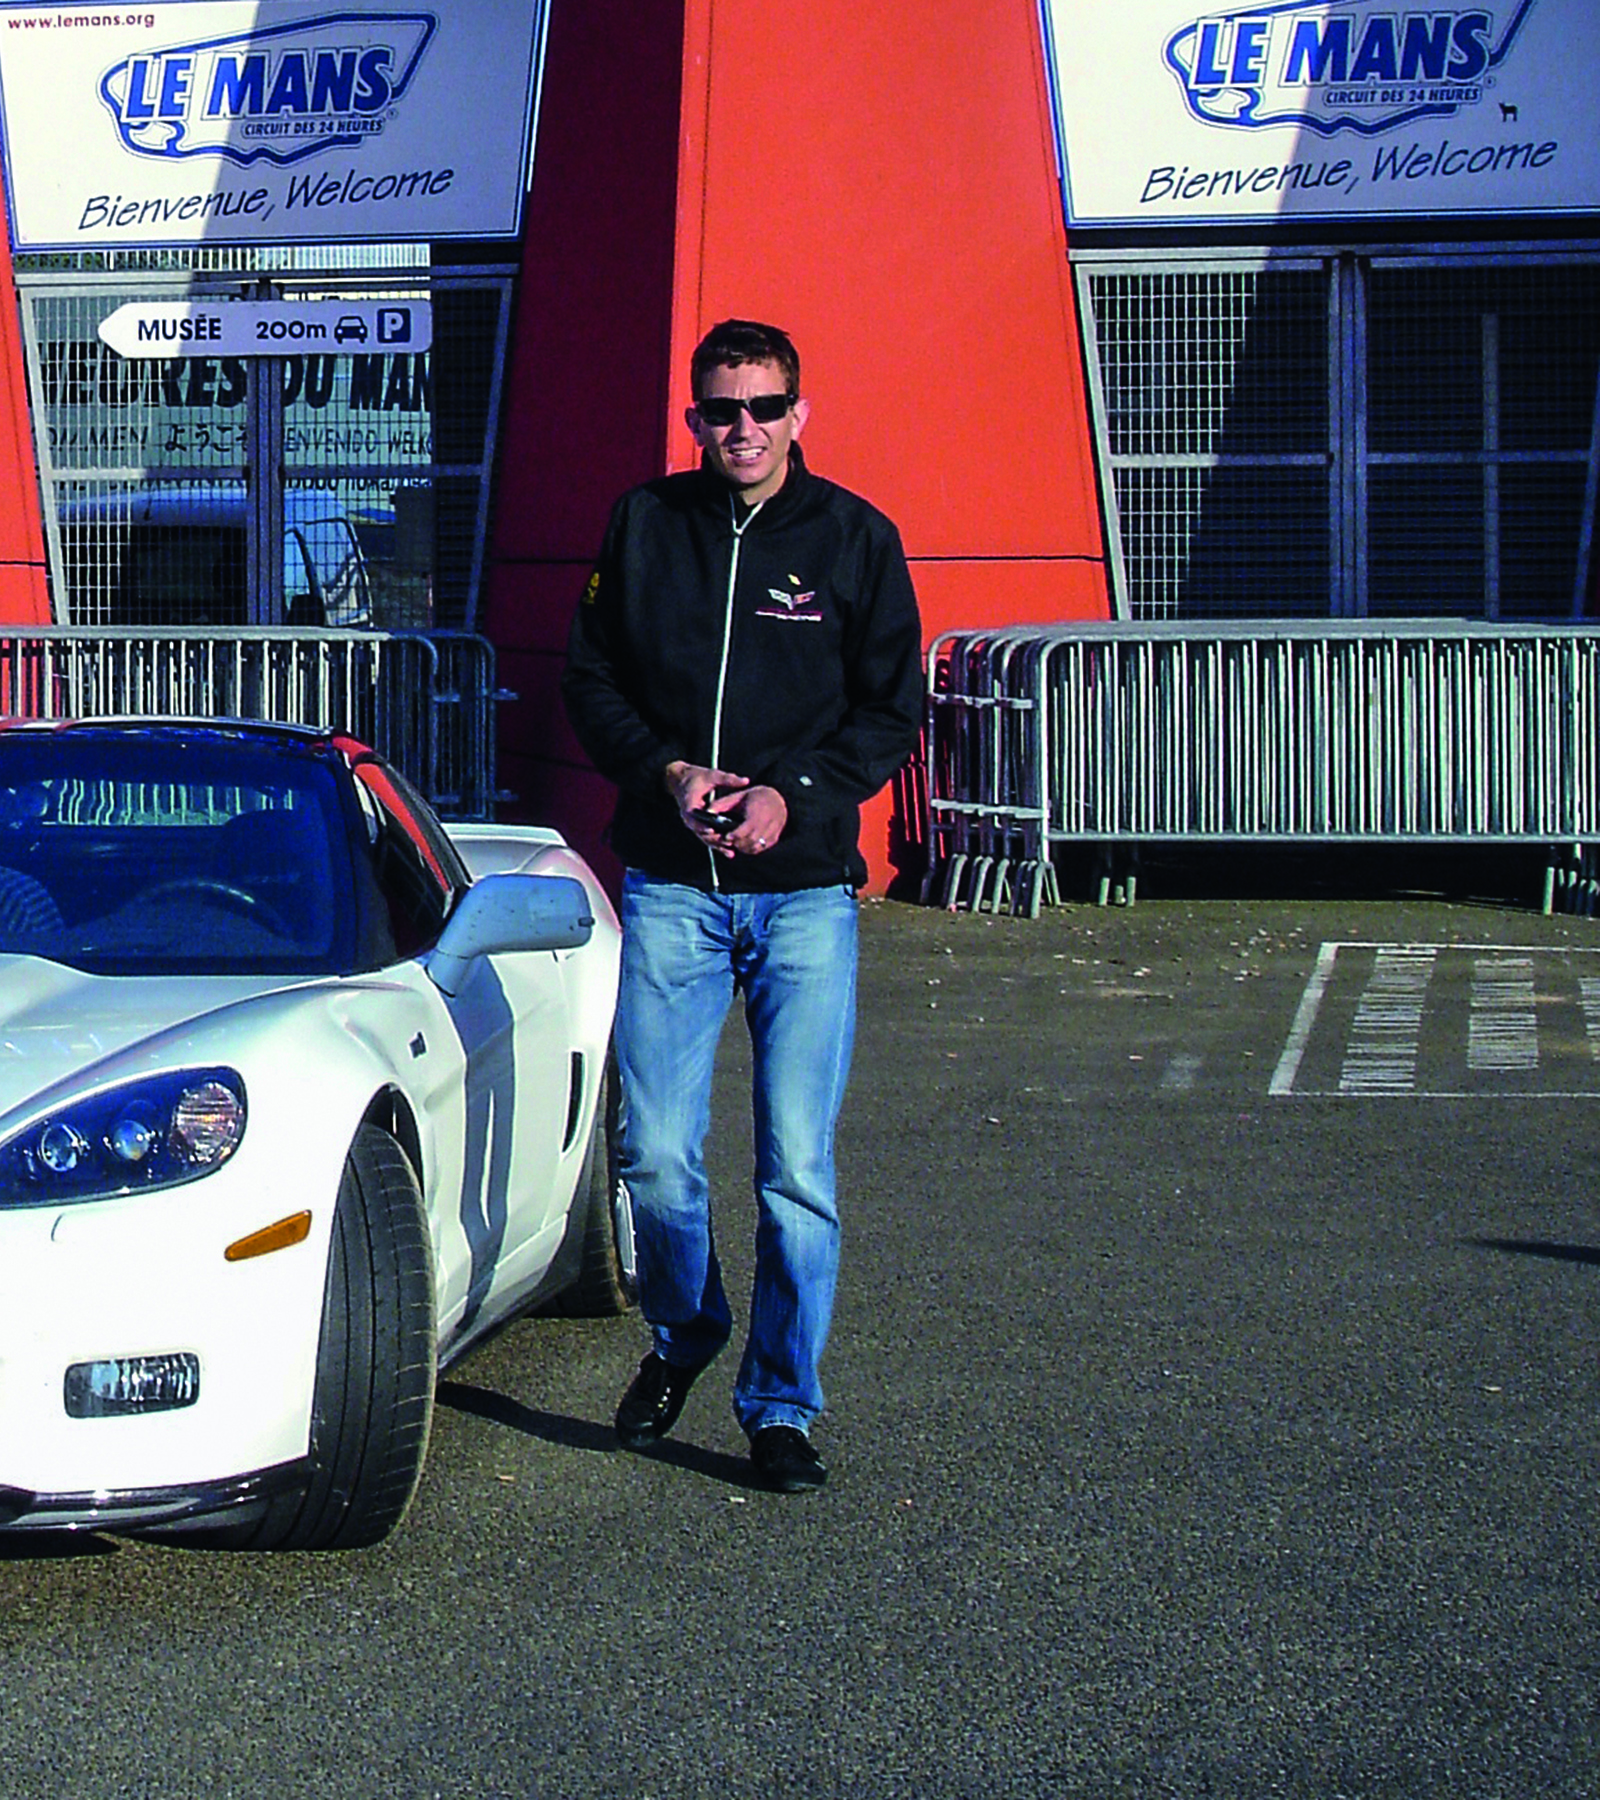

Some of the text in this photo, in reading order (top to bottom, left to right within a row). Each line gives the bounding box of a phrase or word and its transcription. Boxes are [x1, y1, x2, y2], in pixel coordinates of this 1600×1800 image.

[6, 12, 156, 30] www.lemans.org
[1192, 13, 1492, 87] LE MANS
[124, 48, 394, 120] LE MANS
[1326, 87, 1480, 104] CIRCUIT DES 24 HEURES
[244, 119, 383, 135] CIRCUIT DES 24 HEURES
[1139, 138, 1559, 203] Bienvenue, Welcome
[77, 166, 455, 231] Bienvenue, Welcome
[137, 313, 222, 341] MUSÉE
[255, 319, 327, 341] 200m
